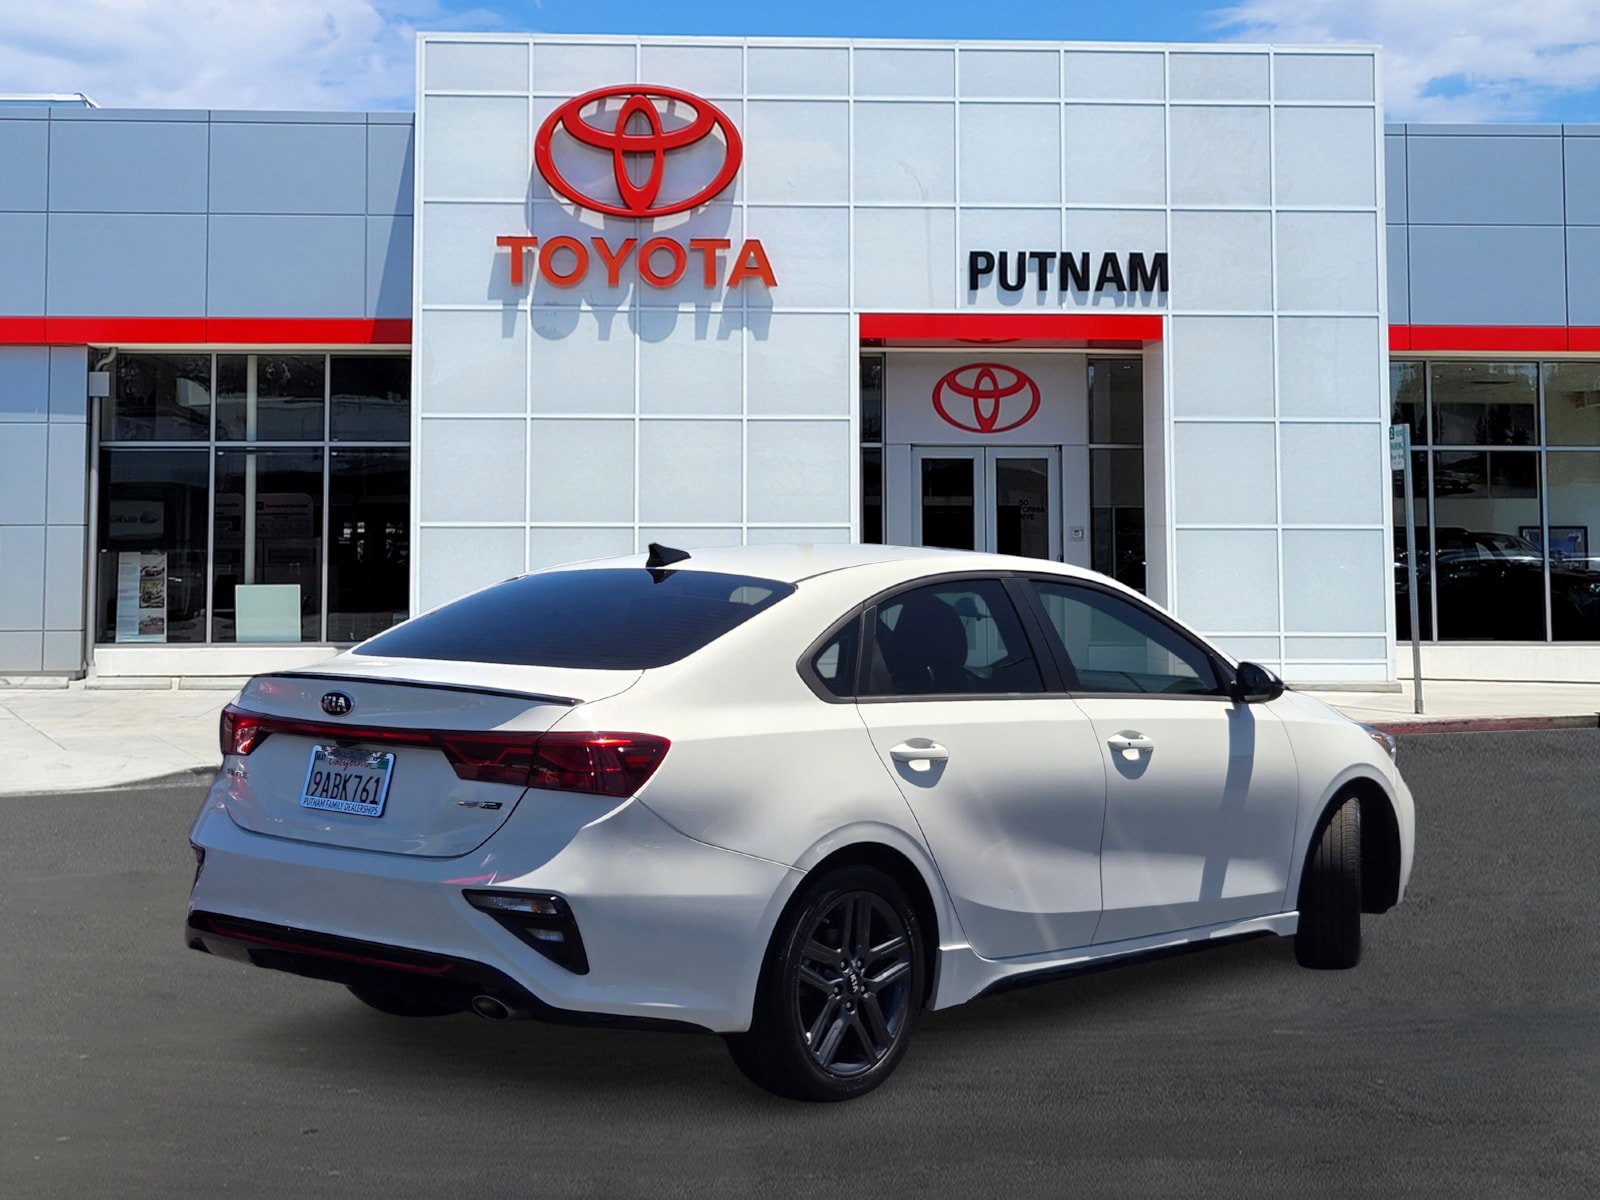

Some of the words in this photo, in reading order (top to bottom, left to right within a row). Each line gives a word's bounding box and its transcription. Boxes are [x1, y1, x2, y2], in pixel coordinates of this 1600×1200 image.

[496, 235, 778, 287] TOYOTA
[969, 251, 1169, 292] PUTNAM
[322, 695, 347, 712] KIA
[310, 771, 380, 804] 9ABK761
[304, 797, 325, 808] PUTNAM
[326, 801, 344, 811] FAMILY
[344, 803, 378, 815] DEALERSHIPS
[850, 974, 858, 993] KIA
